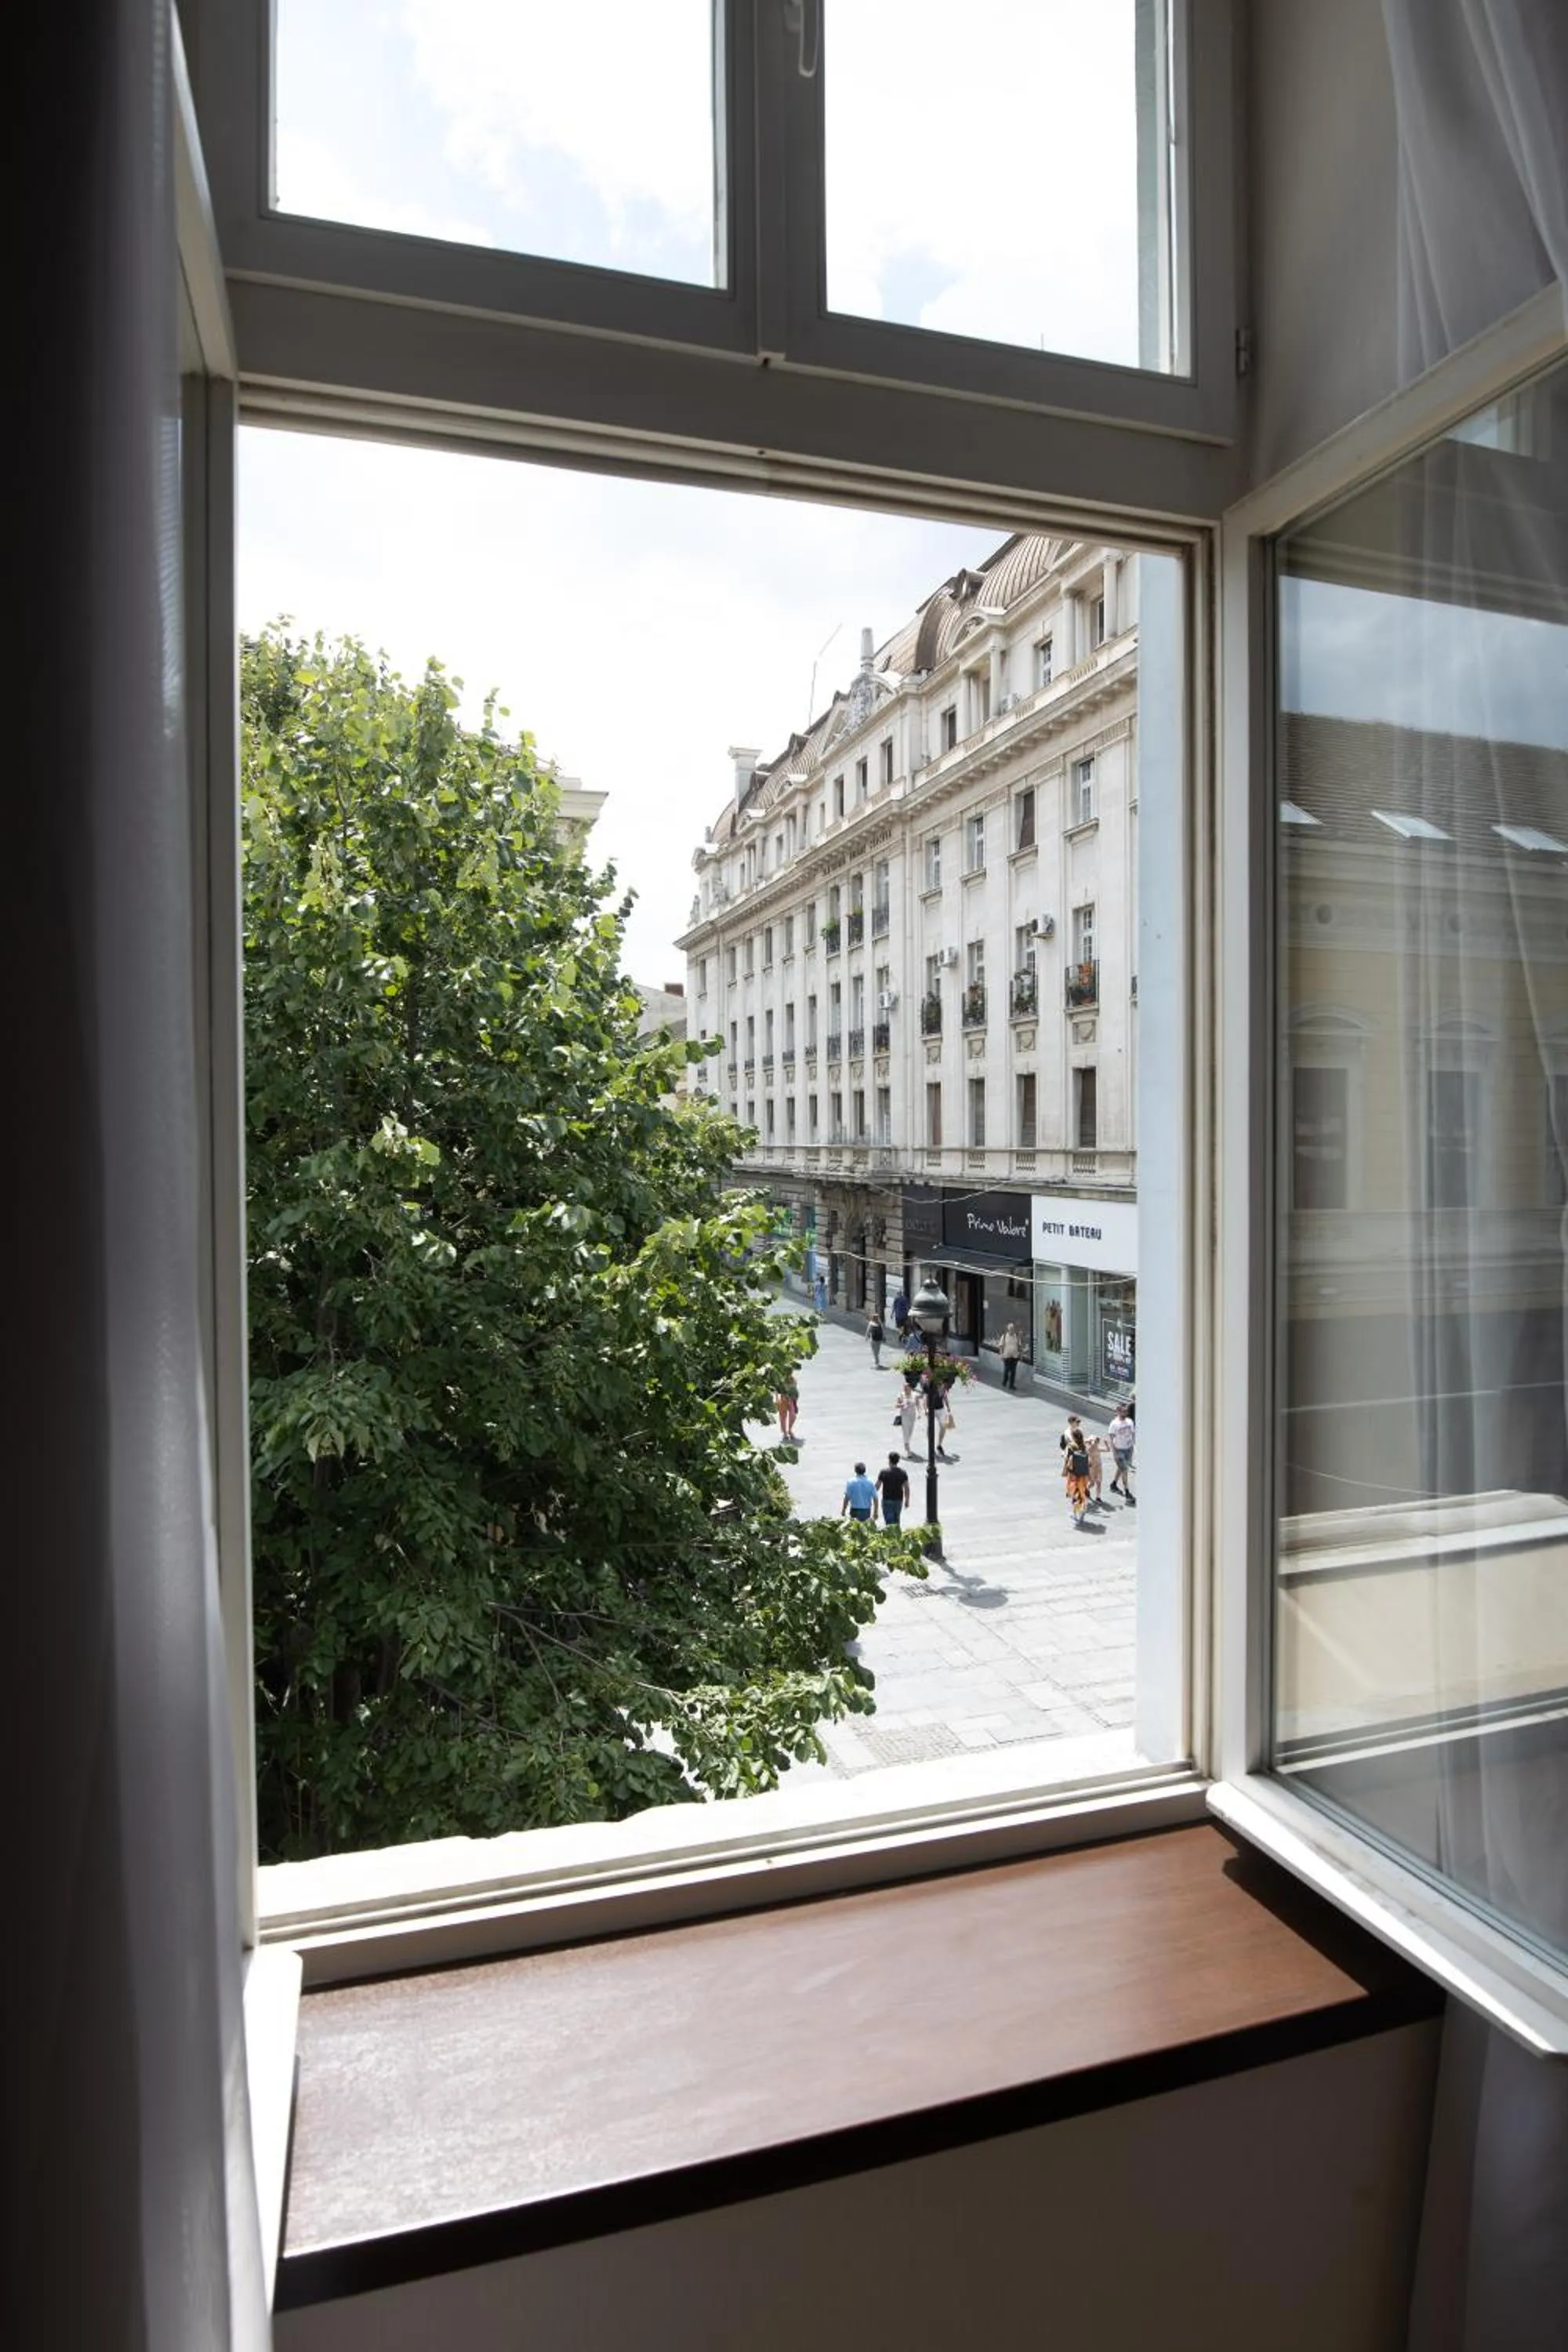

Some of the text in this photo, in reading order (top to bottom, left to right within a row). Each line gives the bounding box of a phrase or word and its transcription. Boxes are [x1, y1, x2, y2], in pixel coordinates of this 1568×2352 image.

[1042, 1221, 1102, 1240] PETIT BATEAU
[1107, 1330, 1131, 1356] SALE
